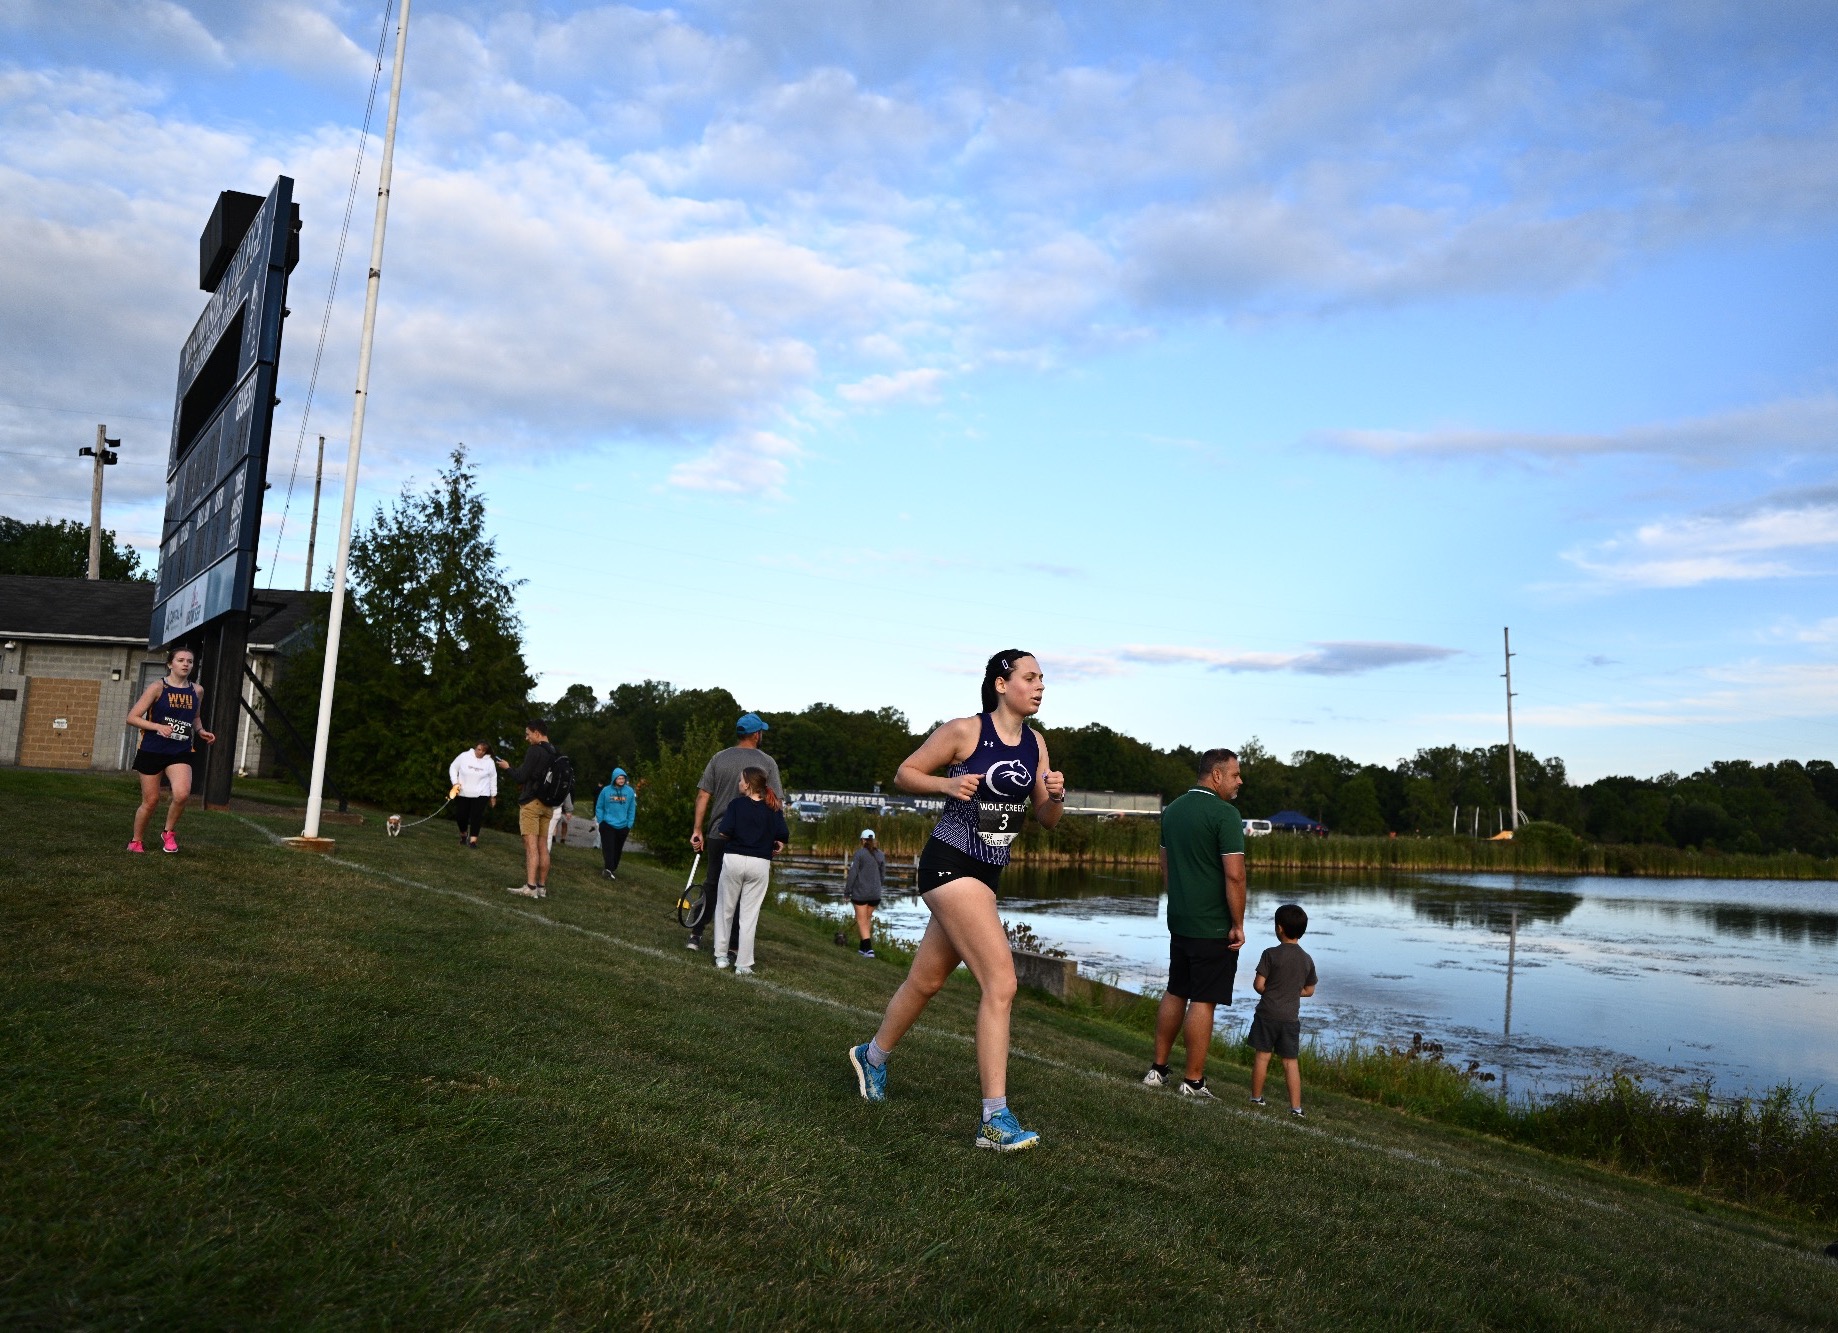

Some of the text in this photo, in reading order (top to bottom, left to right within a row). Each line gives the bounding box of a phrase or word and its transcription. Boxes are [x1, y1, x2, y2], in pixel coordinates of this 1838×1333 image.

[236, 372, 258, 422] GUEST
[168, 693, 192, 705] WVU
[804, 793, 885, 806] WESTMINSTER
[979, 802, 1026, 813] WOLF CREEK
[998, 813, 1010, 831] 3
